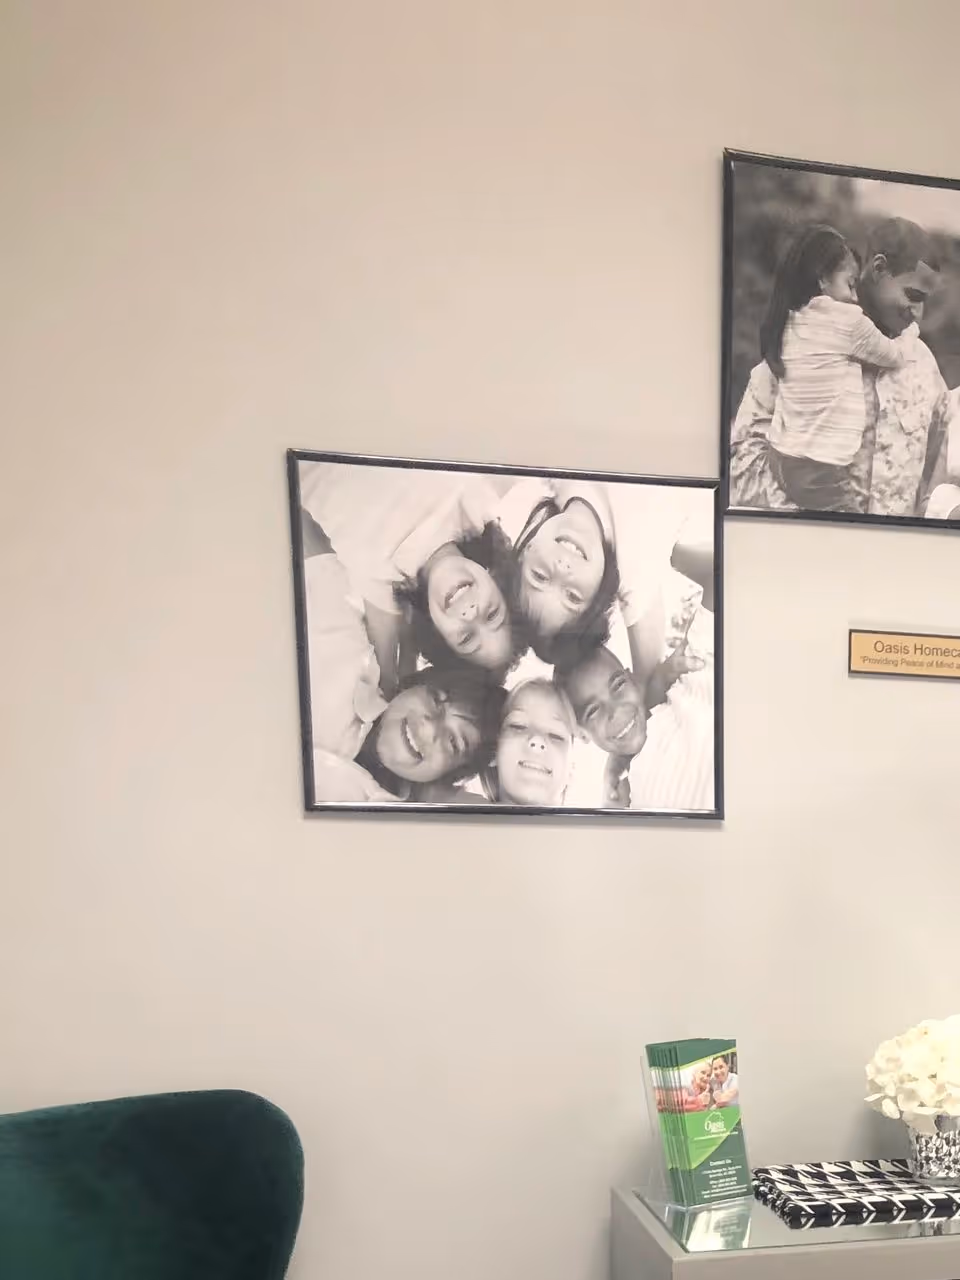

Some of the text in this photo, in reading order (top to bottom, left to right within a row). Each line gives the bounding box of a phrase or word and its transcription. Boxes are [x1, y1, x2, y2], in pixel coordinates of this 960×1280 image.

[874, 640, 910, 655] Oasis
[860, 655, 898, 668] "Providing
[900, 658, 924, 668] Peace
[926, 659, 933, 668] of
[935, 660, 954, 669] Mind
